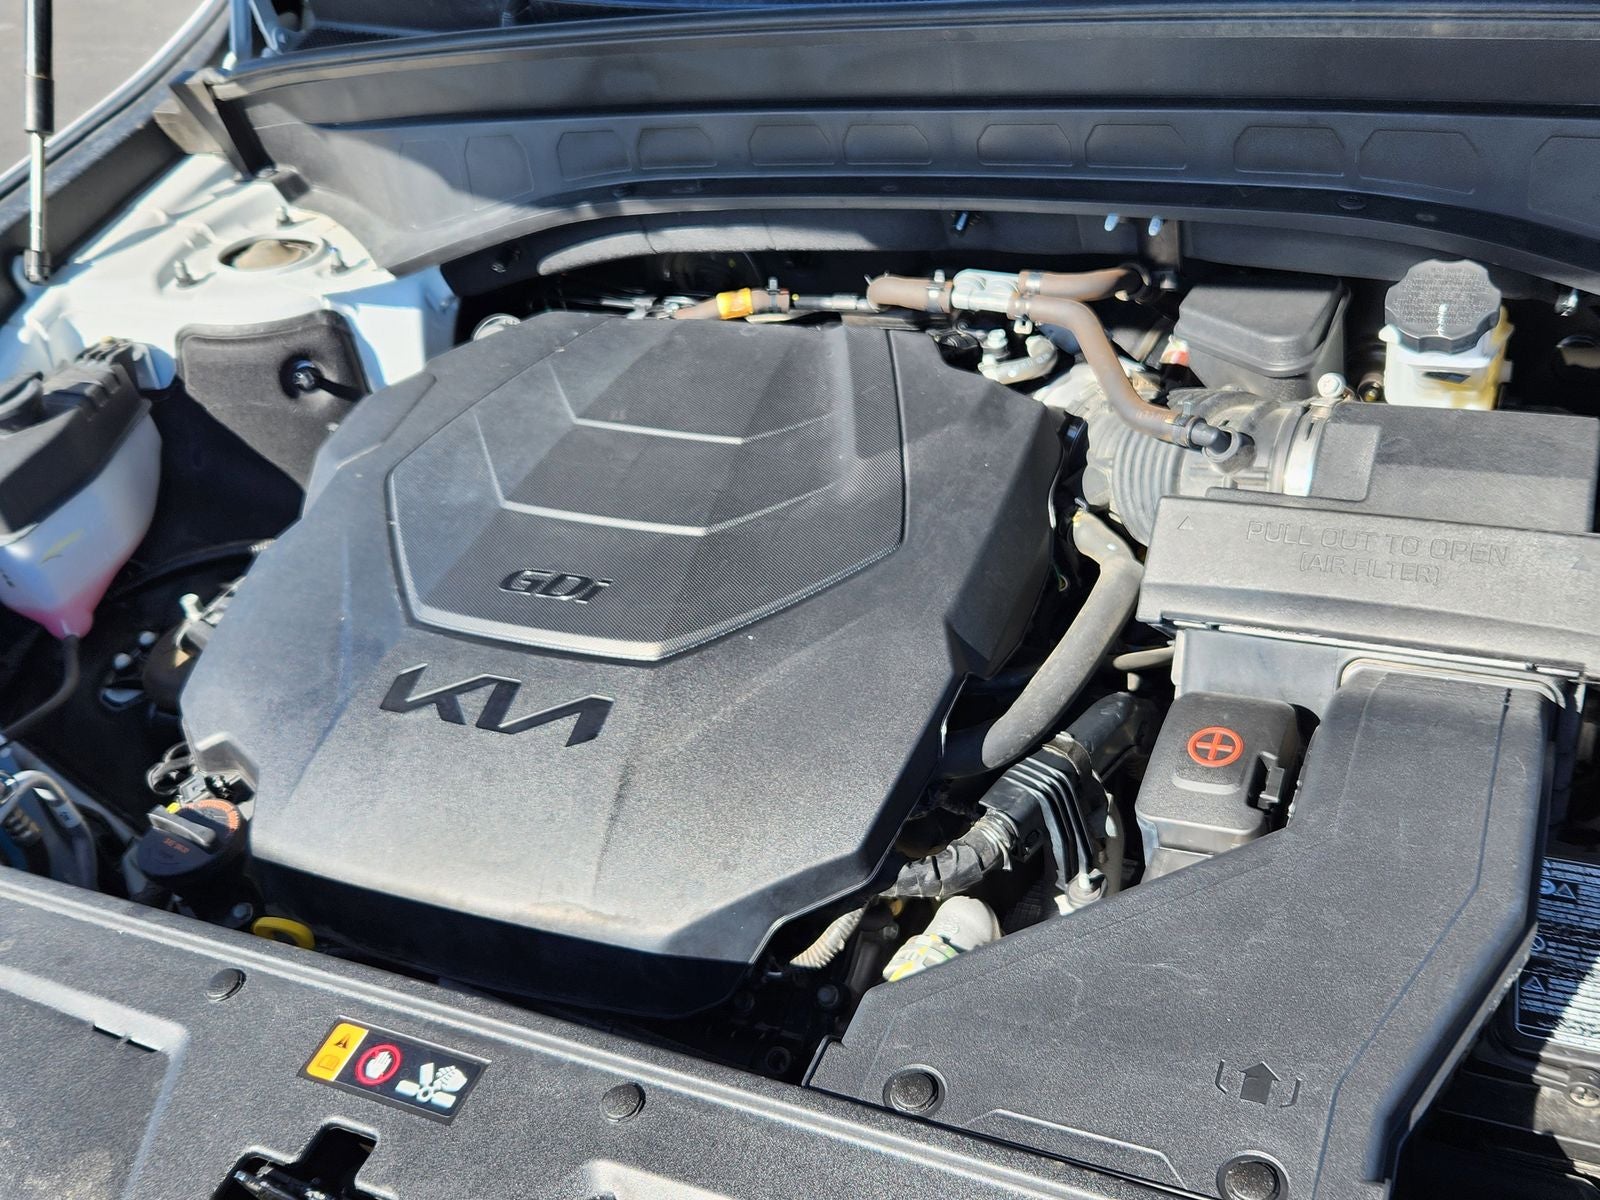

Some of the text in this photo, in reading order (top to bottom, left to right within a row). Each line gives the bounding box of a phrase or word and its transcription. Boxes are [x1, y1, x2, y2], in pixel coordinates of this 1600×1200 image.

[1246, 520, 1510, 567] PULL OUT TO OPEN
[499, 568, 614, 604] GDi
[379, 663, 615, 748] KIA
